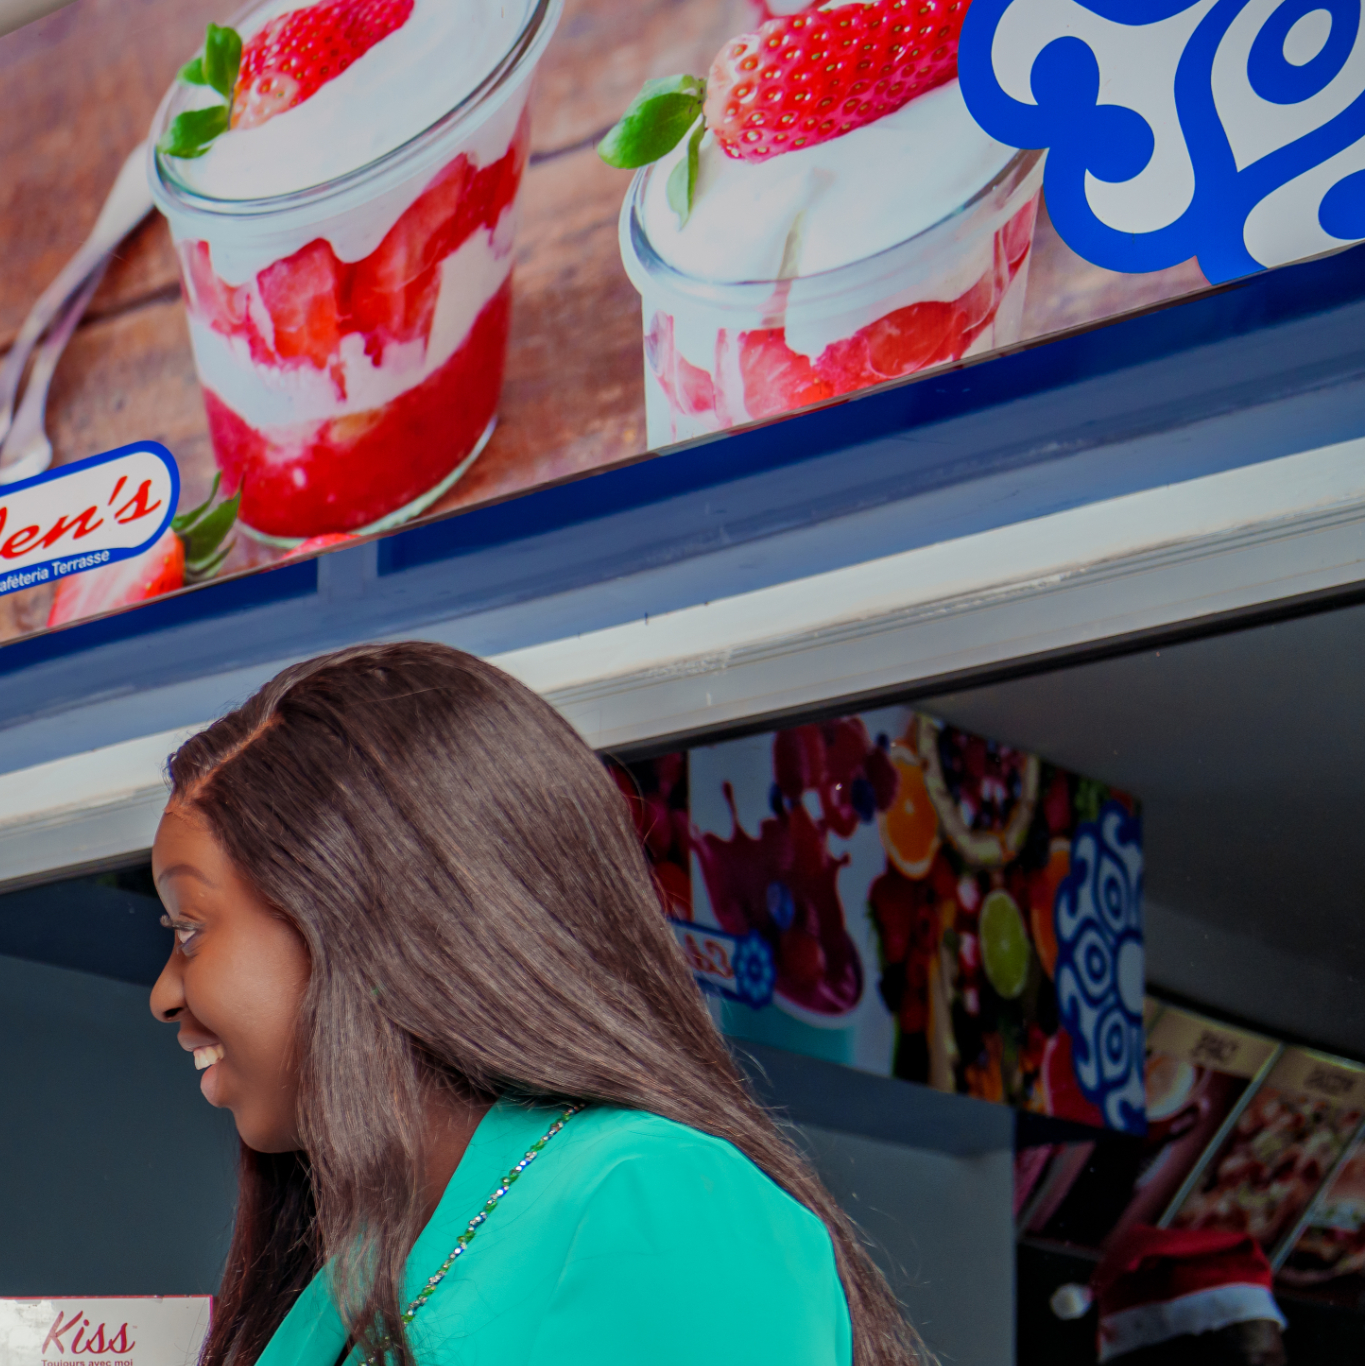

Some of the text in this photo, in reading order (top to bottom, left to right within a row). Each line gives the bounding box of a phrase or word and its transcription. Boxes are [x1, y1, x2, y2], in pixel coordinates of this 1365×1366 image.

[51, 549, 110, 578] Terrasse
[41, 1310, 136, 1355] Kiss
[114, 1358, 133, 1366] moi
